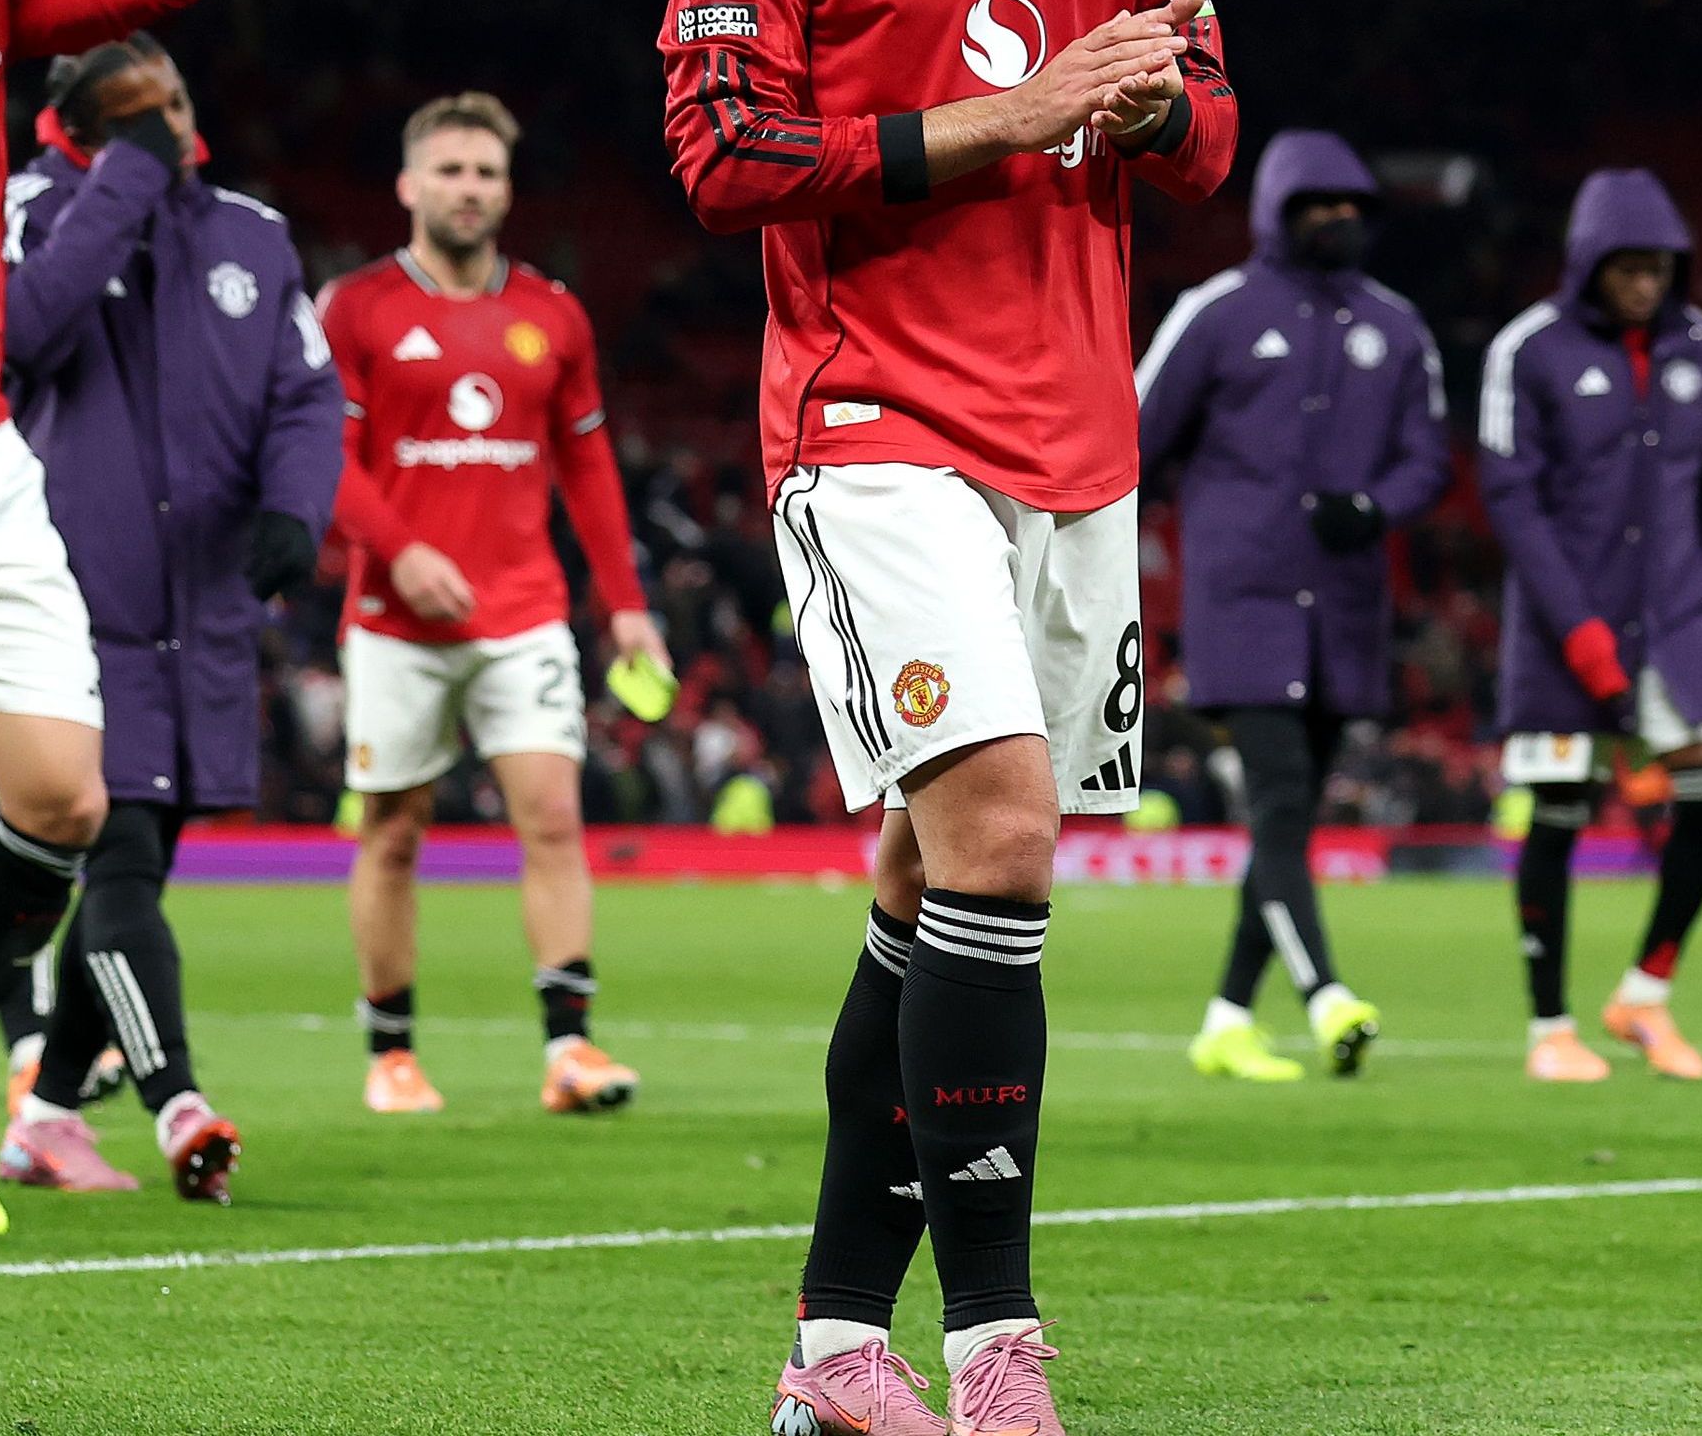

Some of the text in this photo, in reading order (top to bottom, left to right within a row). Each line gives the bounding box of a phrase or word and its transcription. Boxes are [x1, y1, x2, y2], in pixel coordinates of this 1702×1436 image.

[678, 7, 749, 28] No room
[697, 21, 758, 38] racism
[1104, 621, 1141, 733] 8
[911, 704, 942, 723] UNITED
[932, 1084, 1027, 1107] MUFC
